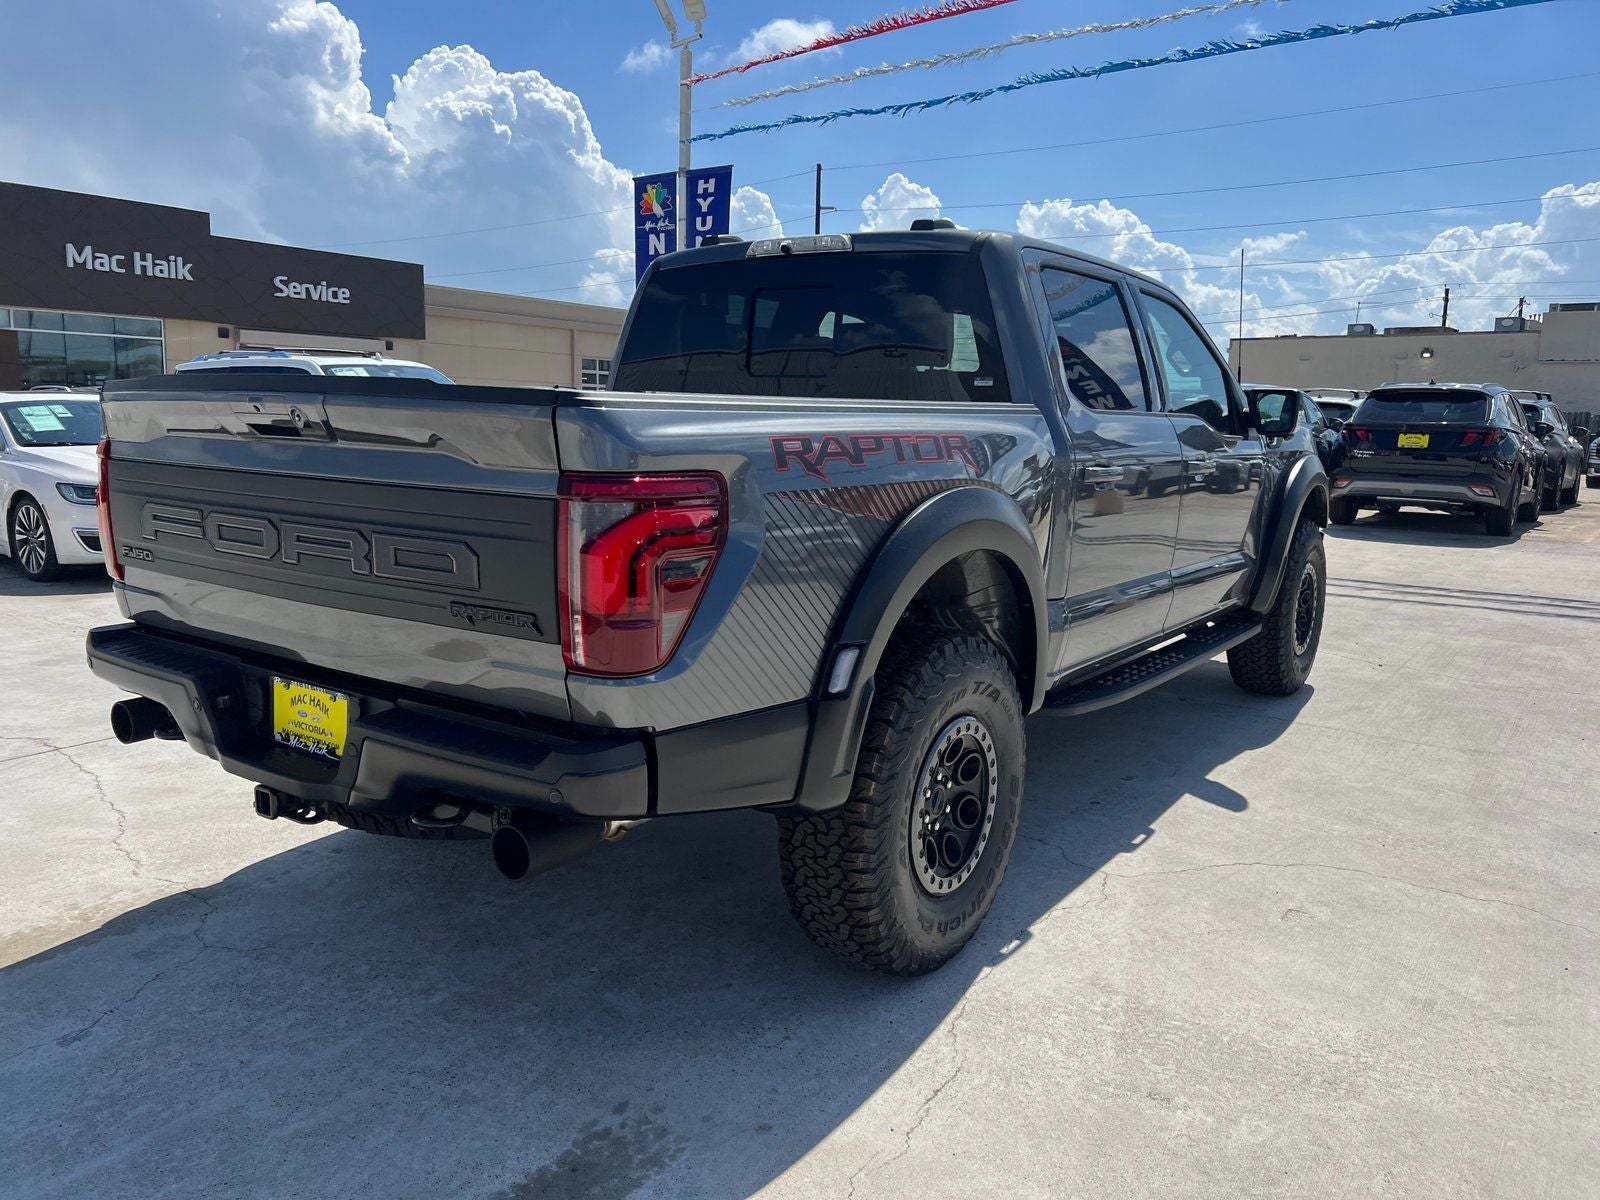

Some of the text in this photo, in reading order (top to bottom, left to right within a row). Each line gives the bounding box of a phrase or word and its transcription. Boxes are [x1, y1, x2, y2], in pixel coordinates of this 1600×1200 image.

[65, 243, 194, 281] Mac Haik
[273, 276, 350, 304] Service
[769, 434, 982, 484] RAPTOR
[140, 500, 480, 591] FORD
[449, 600, 544, 637] RAPTOR
[290, 694, 330, 719] MAC HAIK
[288, 737, 308, 750] Mac
[293, 720, 327, 737] VICTORIA
